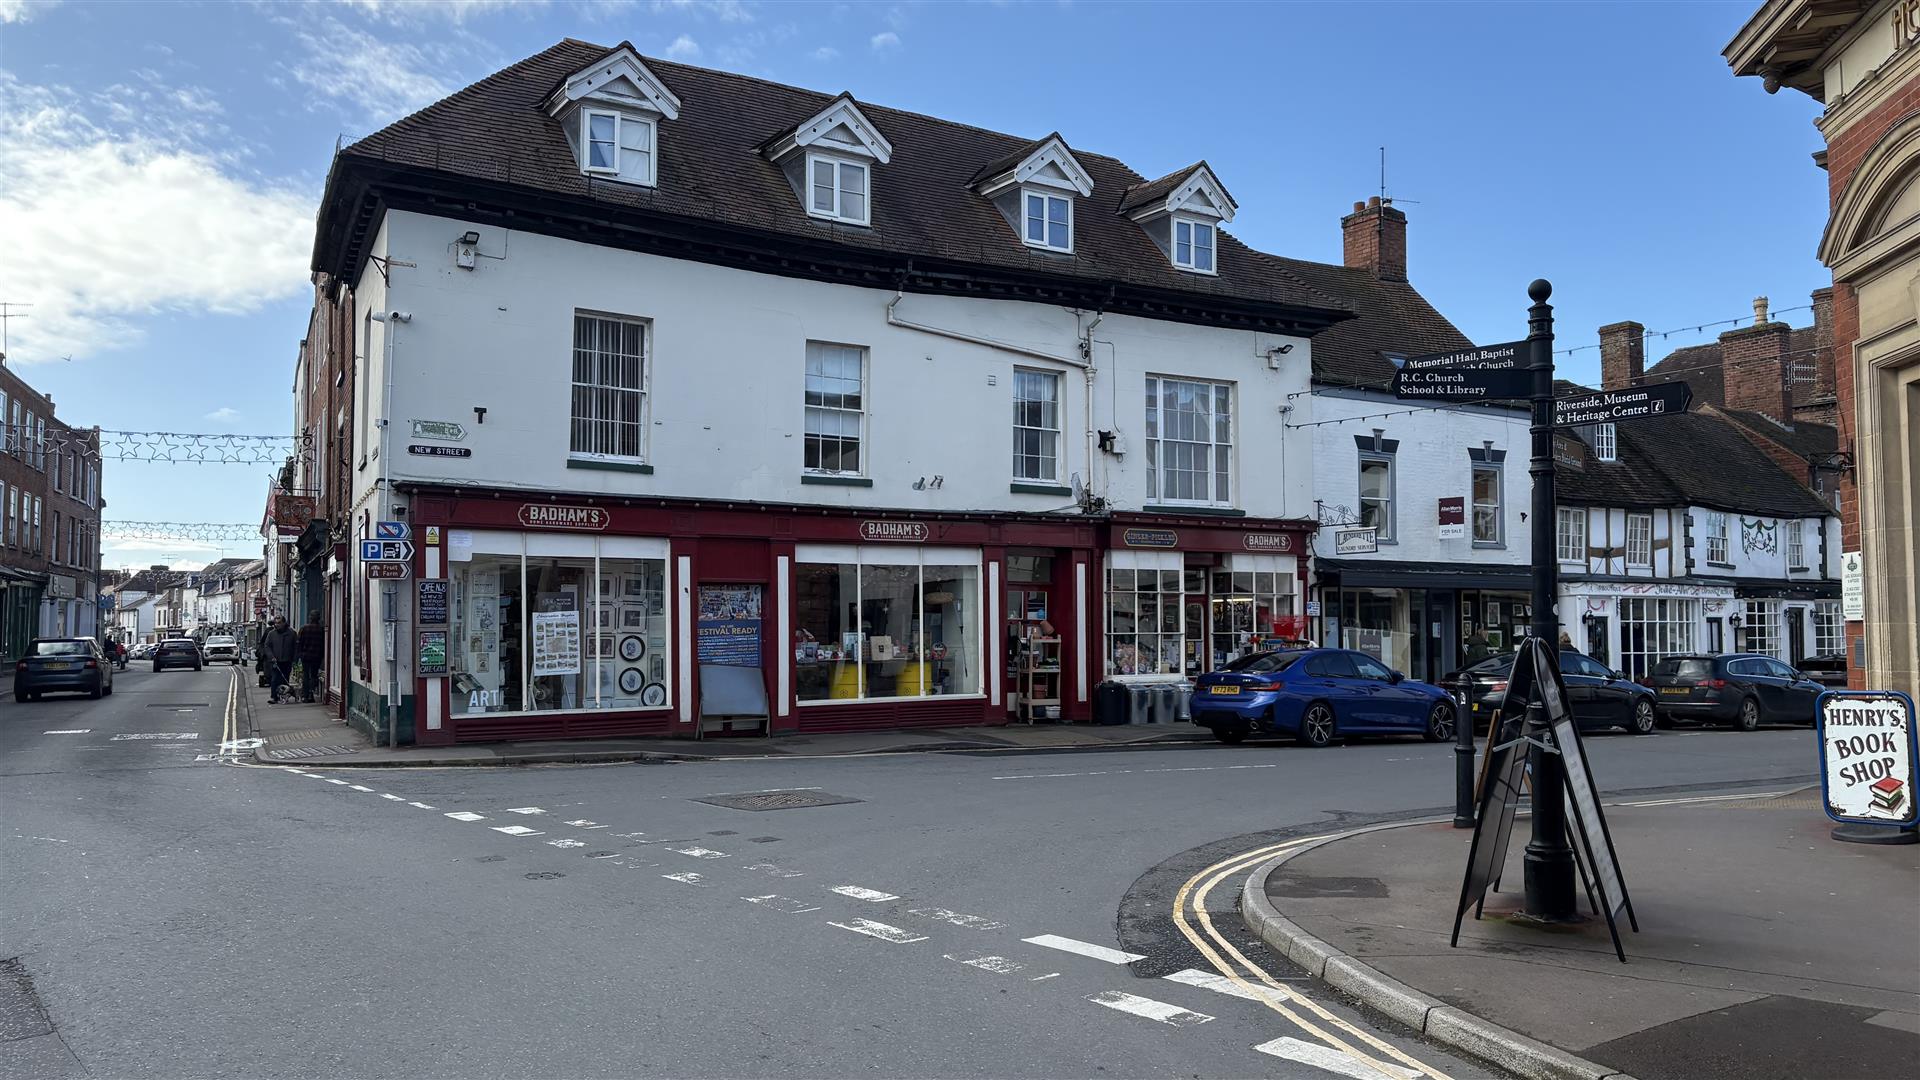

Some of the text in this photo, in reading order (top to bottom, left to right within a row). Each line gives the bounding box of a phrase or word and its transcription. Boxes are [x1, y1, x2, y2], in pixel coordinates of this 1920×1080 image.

[1408, 355, 1454, 370] Memorial
[1455, 352, 1479, 363] Hall,
[1480, 348, 1514, 360] Baptist
[1478, 359, 1514, 370] Church
[1400, 373, 1465, 382] R.C. Church
[1400, 385, 1487, 396] School & Library
[1556, 392, 1648, 412] Riverside, Museum
[1556, 414, 1565, 424] &
[1566, 408, 1611, 422] Heritage
[1612, 405, 1649, 418] Centre
[414, 446, 466, 456] NEW STREET
[530, 506, 600, 523] BADHAM'S
[868, 522, 921, 536] BADHAM'S
[1249, 535, 1287, 546] BADHAM'S
[367, 543, 379, 557] P
[420, 582, 435, 593] CAFE
[731, 626, 758, 635] READY
[469, 690, 499, 707] ART
[1829, 708, 1901, 727] HENRY'S
[1834, 732, 1897, 760] BOOK
[1839, 756, 1896, 788] SHOP
